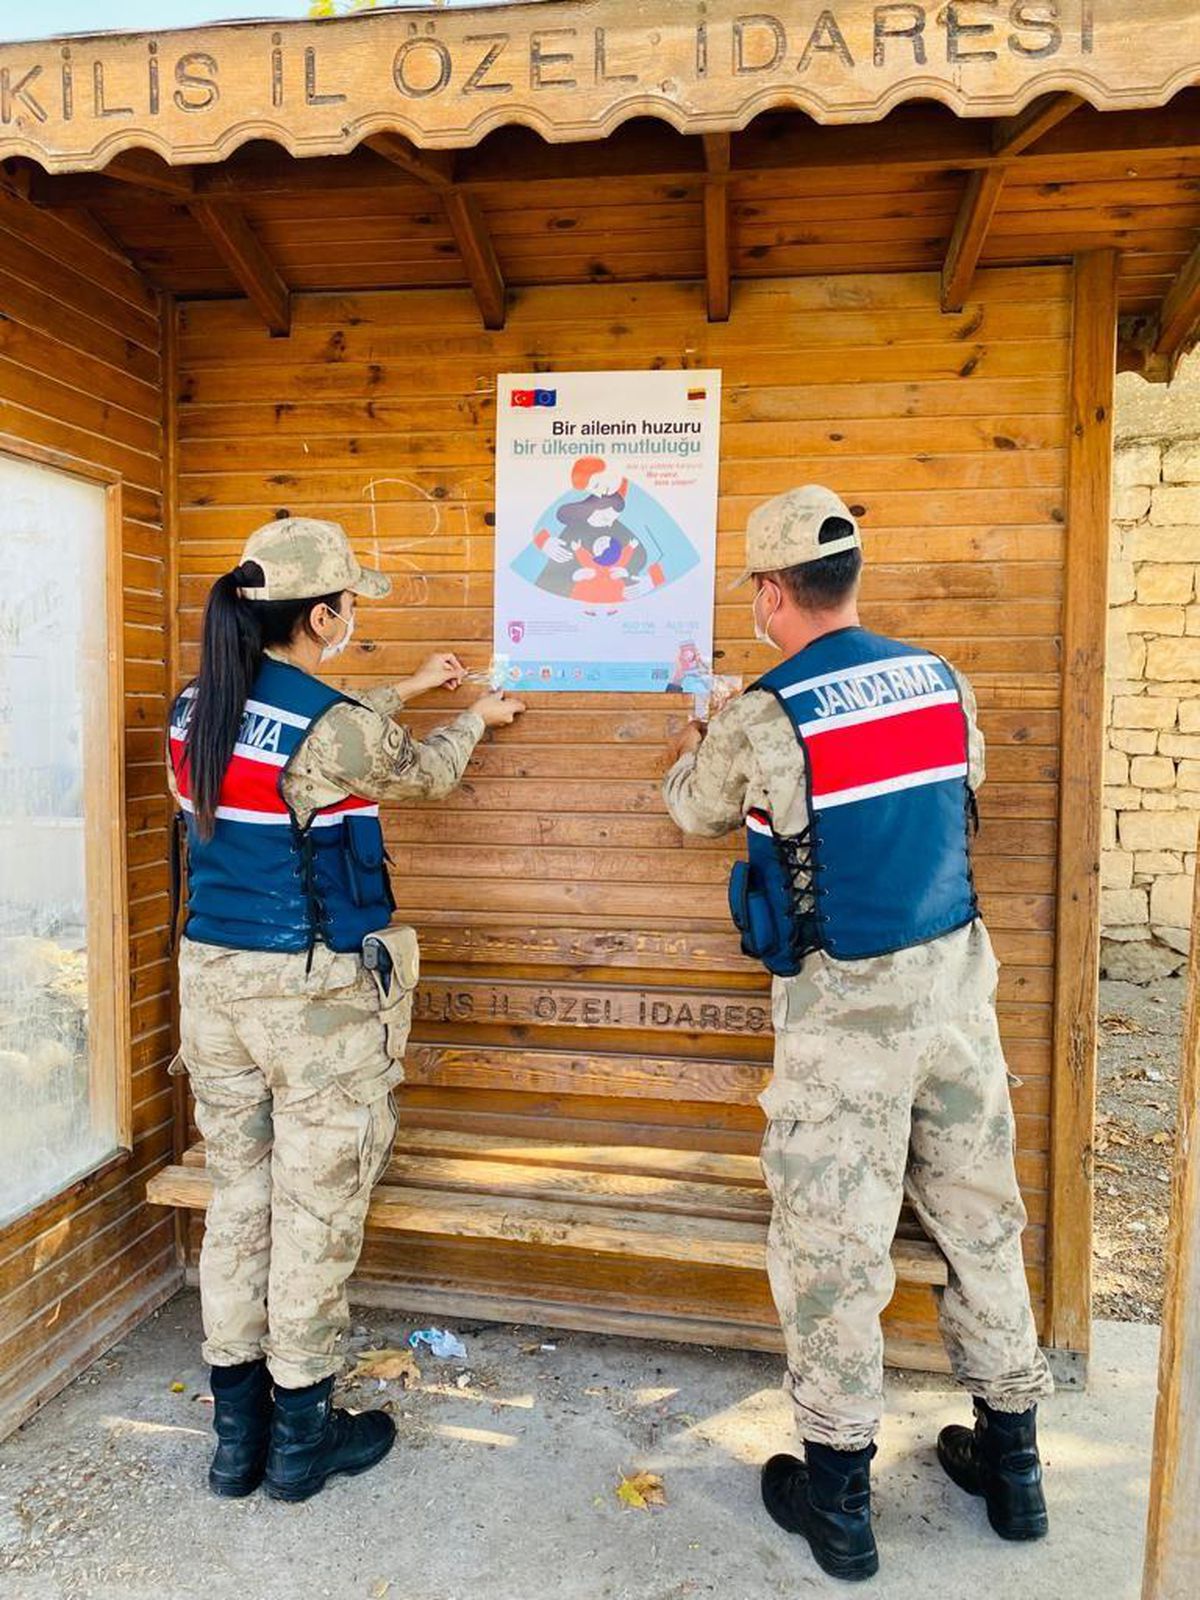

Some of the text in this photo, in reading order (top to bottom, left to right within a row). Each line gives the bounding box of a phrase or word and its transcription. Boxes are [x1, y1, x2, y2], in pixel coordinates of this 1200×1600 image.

[0, 40, 221, 125] KİLİS
[271, 31, 348, 107] İL
[392, 20, 639, 98] ÖZEL
[513, 436, 701, 457] bir ülkenin mutluluğu
[552, 420, 701, 435] Bir ailenin huzuru
[813, 664, 947, 718] JANDARMA
[533, 988, 622, 1024] ÖZEL
[639, 991, 767, 1032] İDARES
